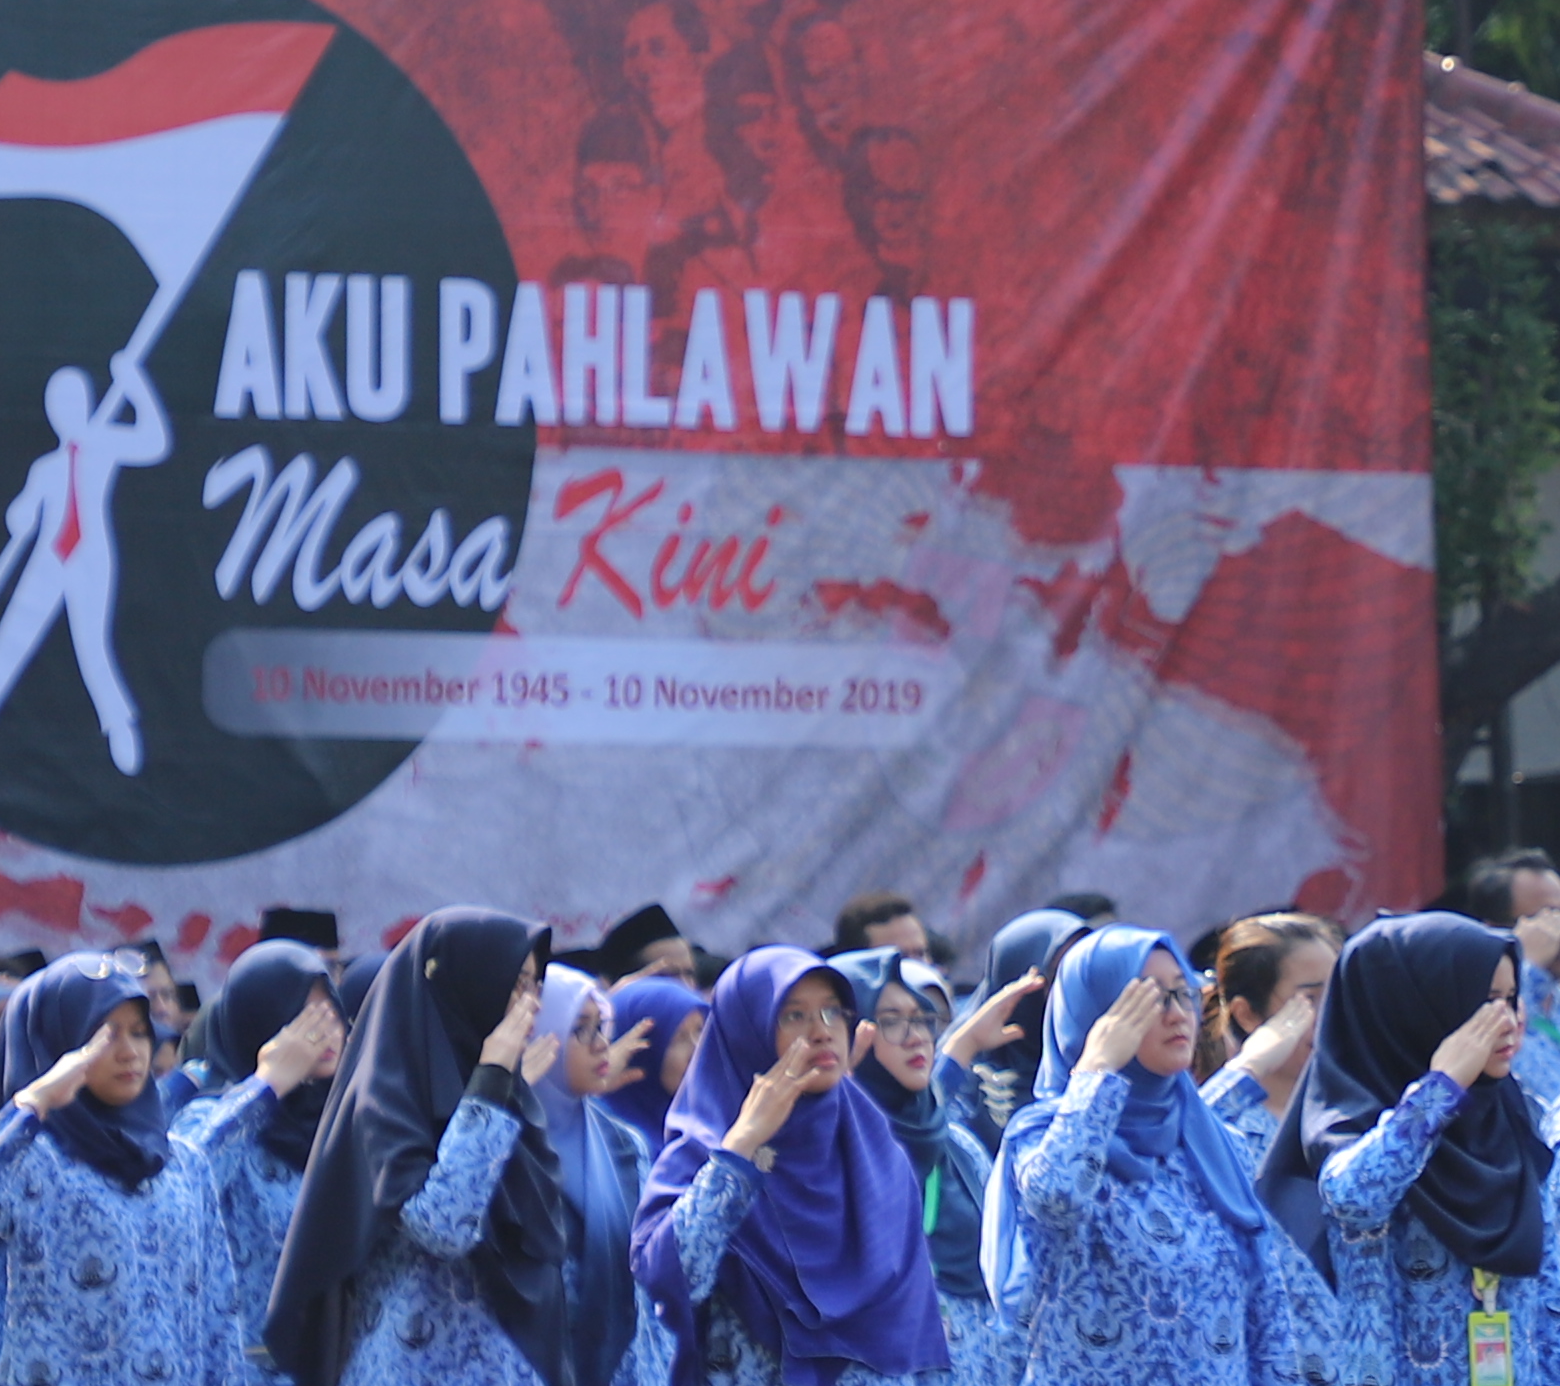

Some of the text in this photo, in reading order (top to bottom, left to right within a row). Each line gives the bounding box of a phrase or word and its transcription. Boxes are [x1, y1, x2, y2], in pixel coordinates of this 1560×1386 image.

[214, 269, 975, 439] AKU PAHLAWAN
[201, 443, 787, 617] Masa Kini
[250, 665, 293, 703] 10
[302, 666, 484, 707] November
[492, 669, 570, 708] 1945
[602, 673, 643, 707] 10
[652, 675, 832, 713] November
[840, 677, 924, 715] 2019
